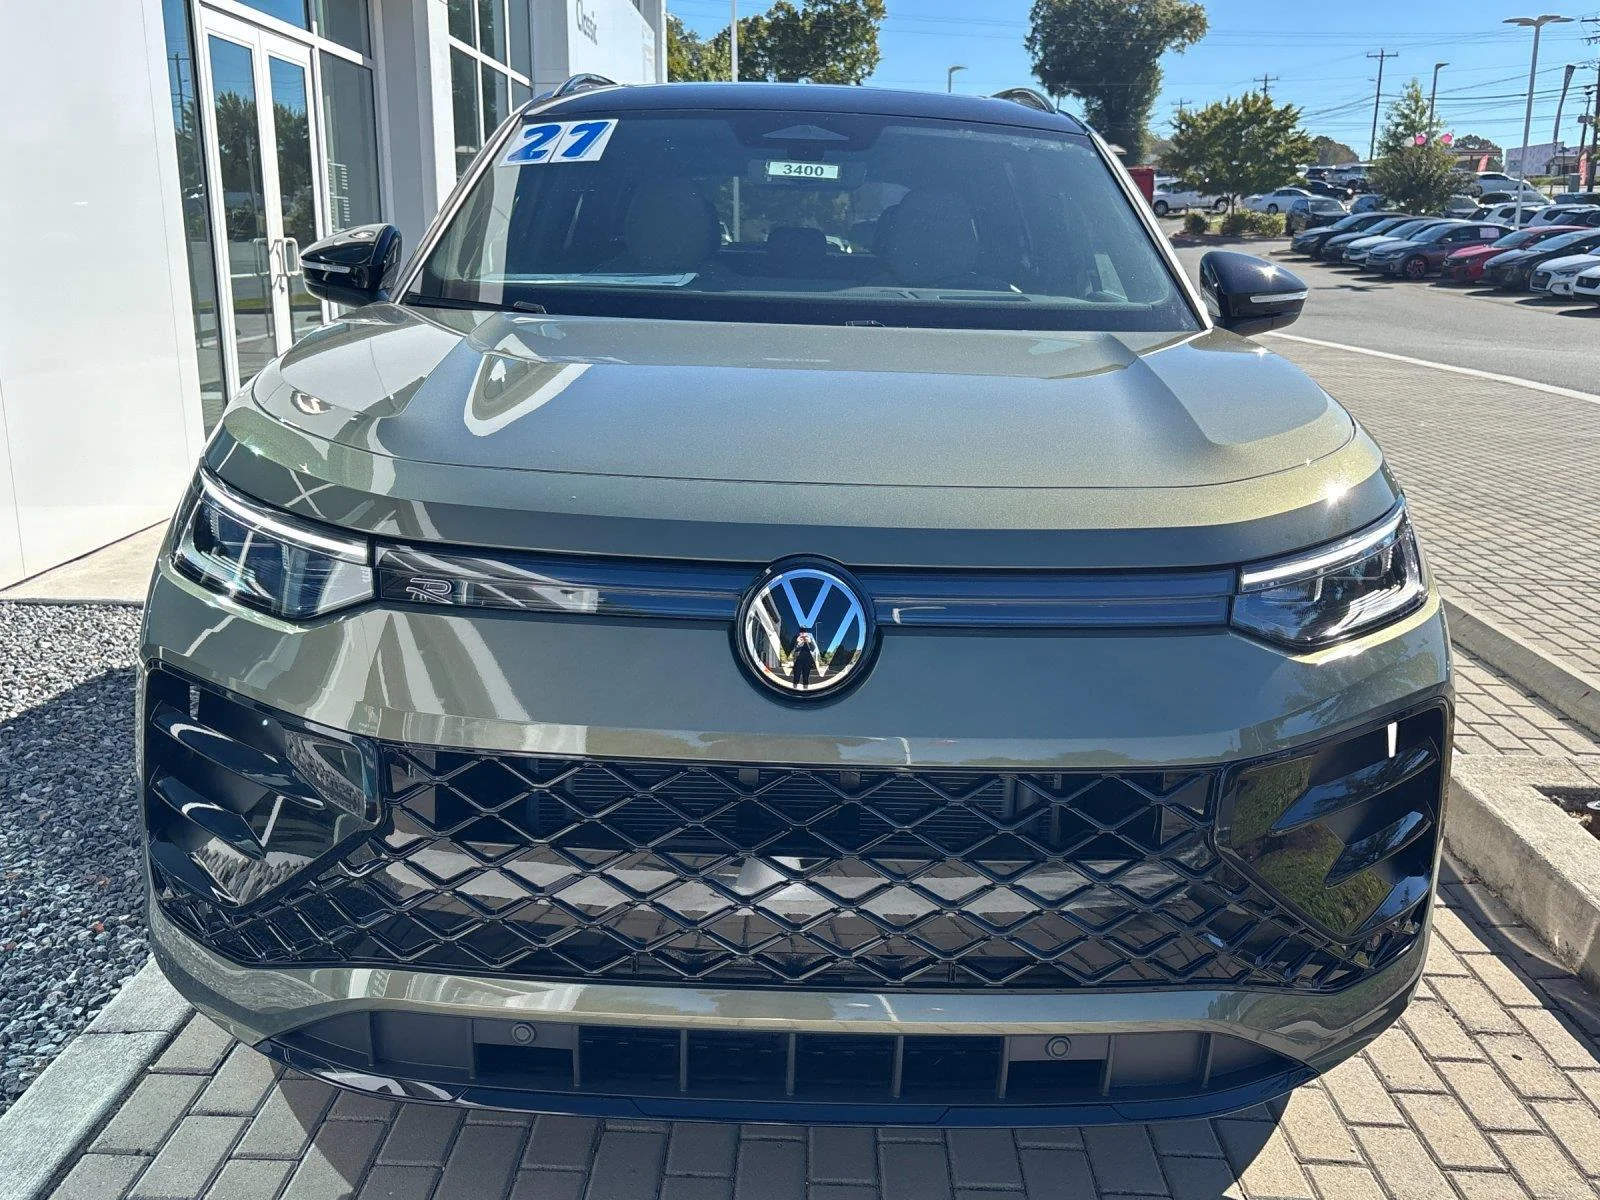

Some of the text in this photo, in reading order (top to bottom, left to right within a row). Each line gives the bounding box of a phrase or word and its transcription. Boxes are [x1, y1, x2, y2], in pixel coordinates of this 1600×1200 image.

[575, 0, 598, 46] Classic
[782, 164, 824, 177] 3400
[750, 573, 862, 681] VW
